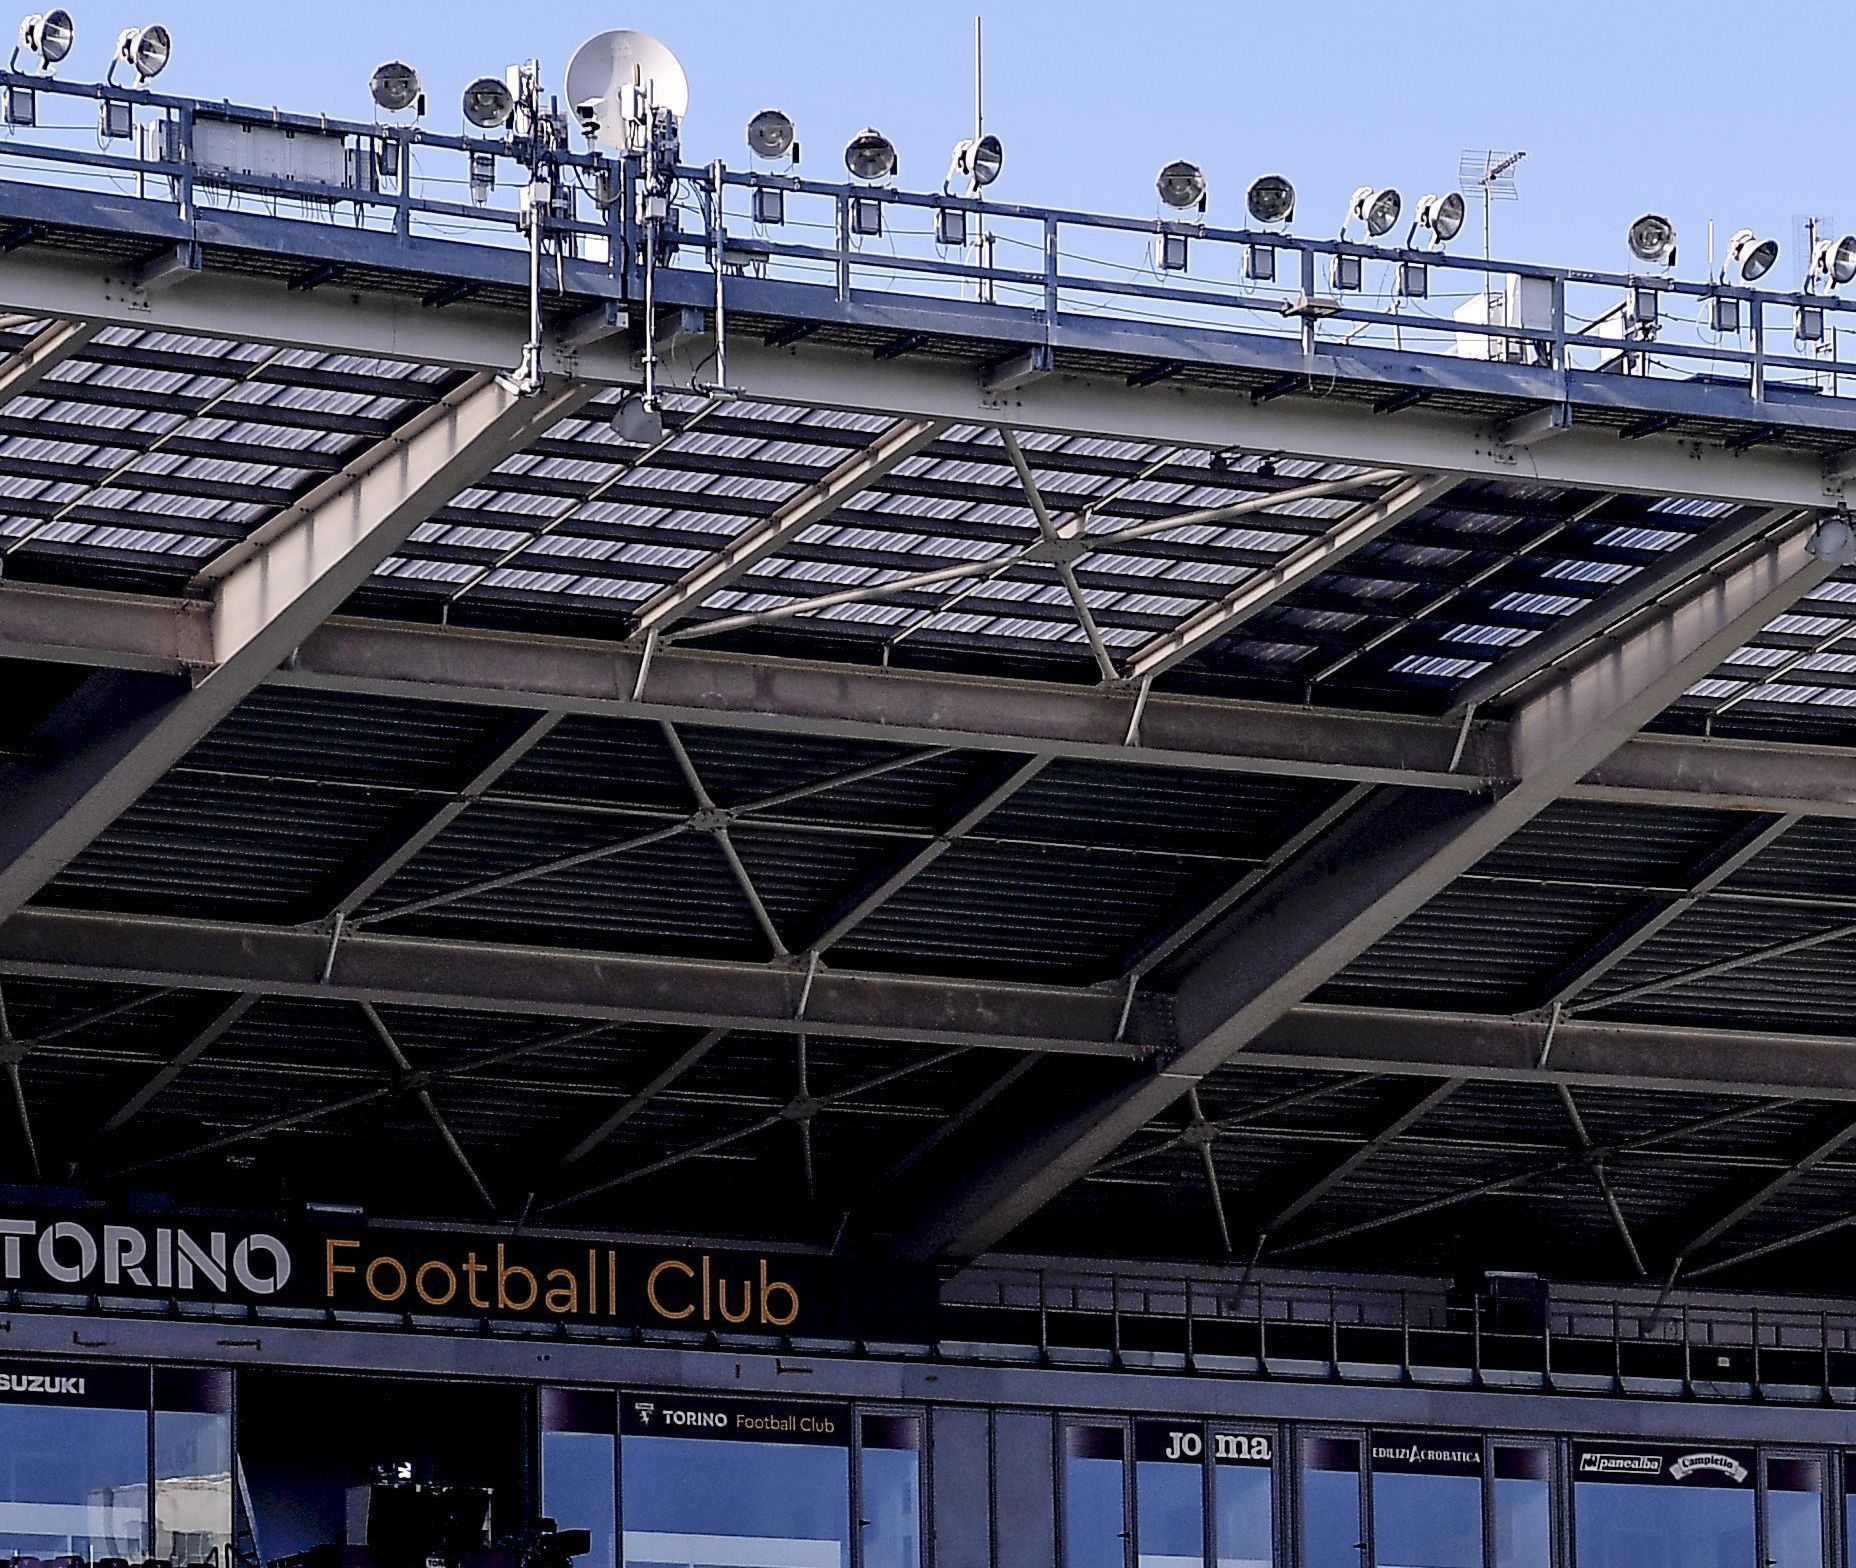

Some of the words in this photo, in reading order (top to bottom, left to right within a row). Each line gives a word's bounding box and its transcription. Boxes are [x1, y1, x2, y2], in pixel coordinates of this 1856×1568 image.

[325, 1238, 618, 1317] Football
[646, 1254, 800, 1327] Club
[662, 1409, 729, 1428] TORINO
[735, 1413, 797, 1433] Football
[800, 1416, 836, 1435] Club
[1599, 1455, 1660, 1474] panealba
[1681, 1453, 1734, 1472] Campiello
